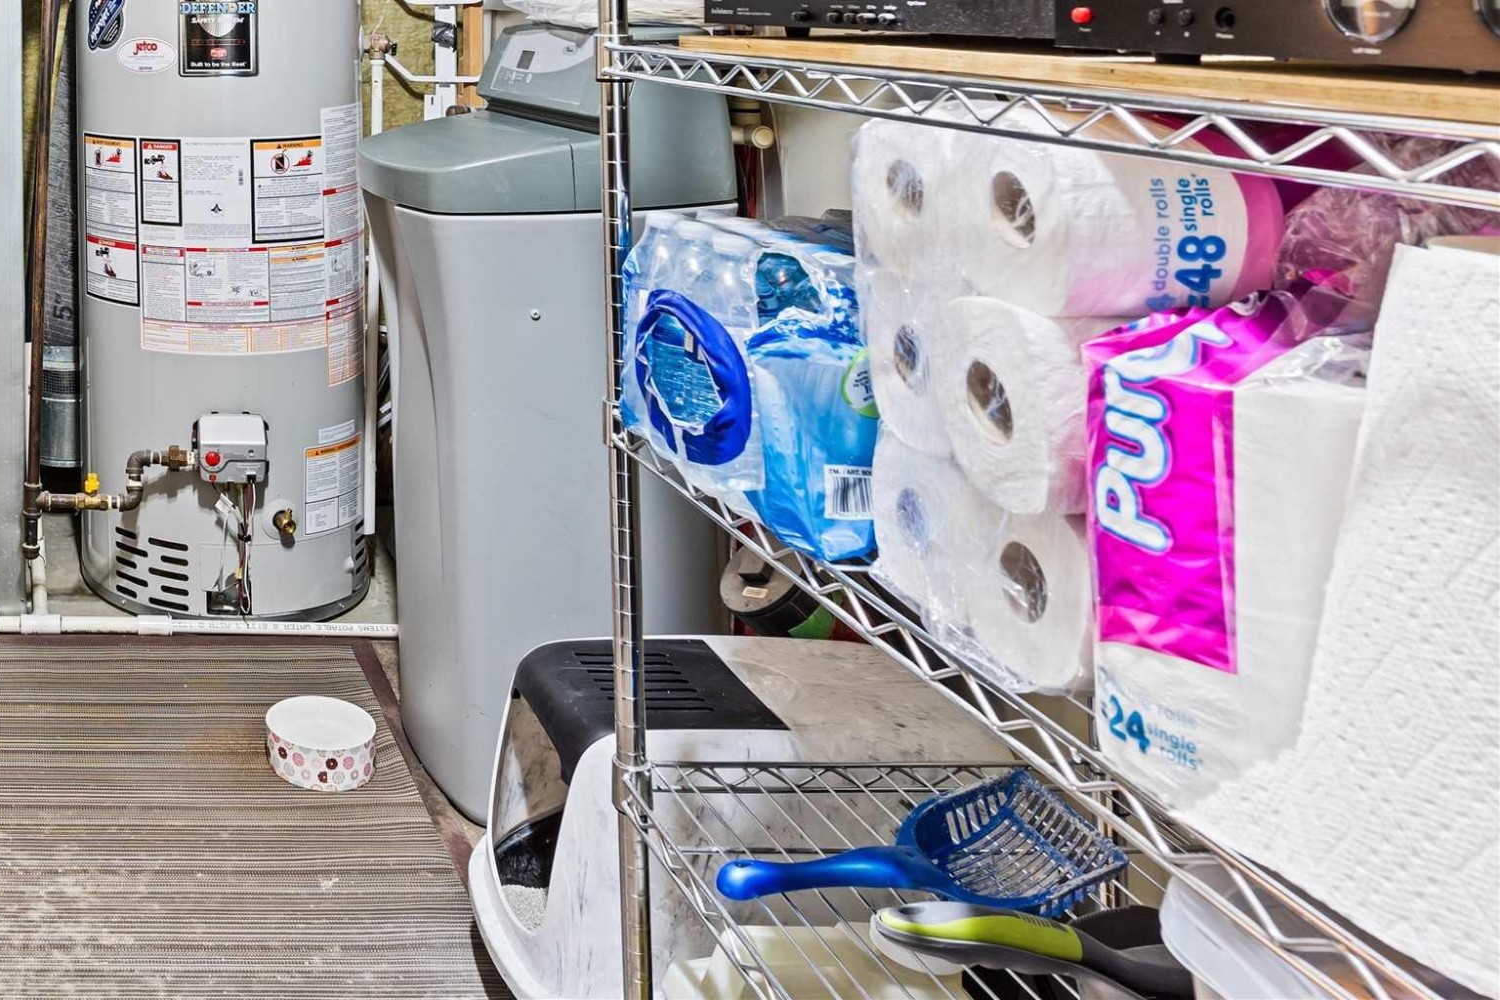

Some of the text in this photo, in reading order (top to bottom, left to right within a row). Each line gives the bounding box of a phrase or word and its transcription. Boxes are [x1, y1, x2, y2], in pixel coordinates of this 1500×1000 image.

[180, 1, 256, 14] DEFENDER
[1149, 178, 1170, 219] rolls
[1176, 178, 1198, 232] single
[1151, 226, 1172, 291] double
[316, 624, 354, 632] POTABLE
